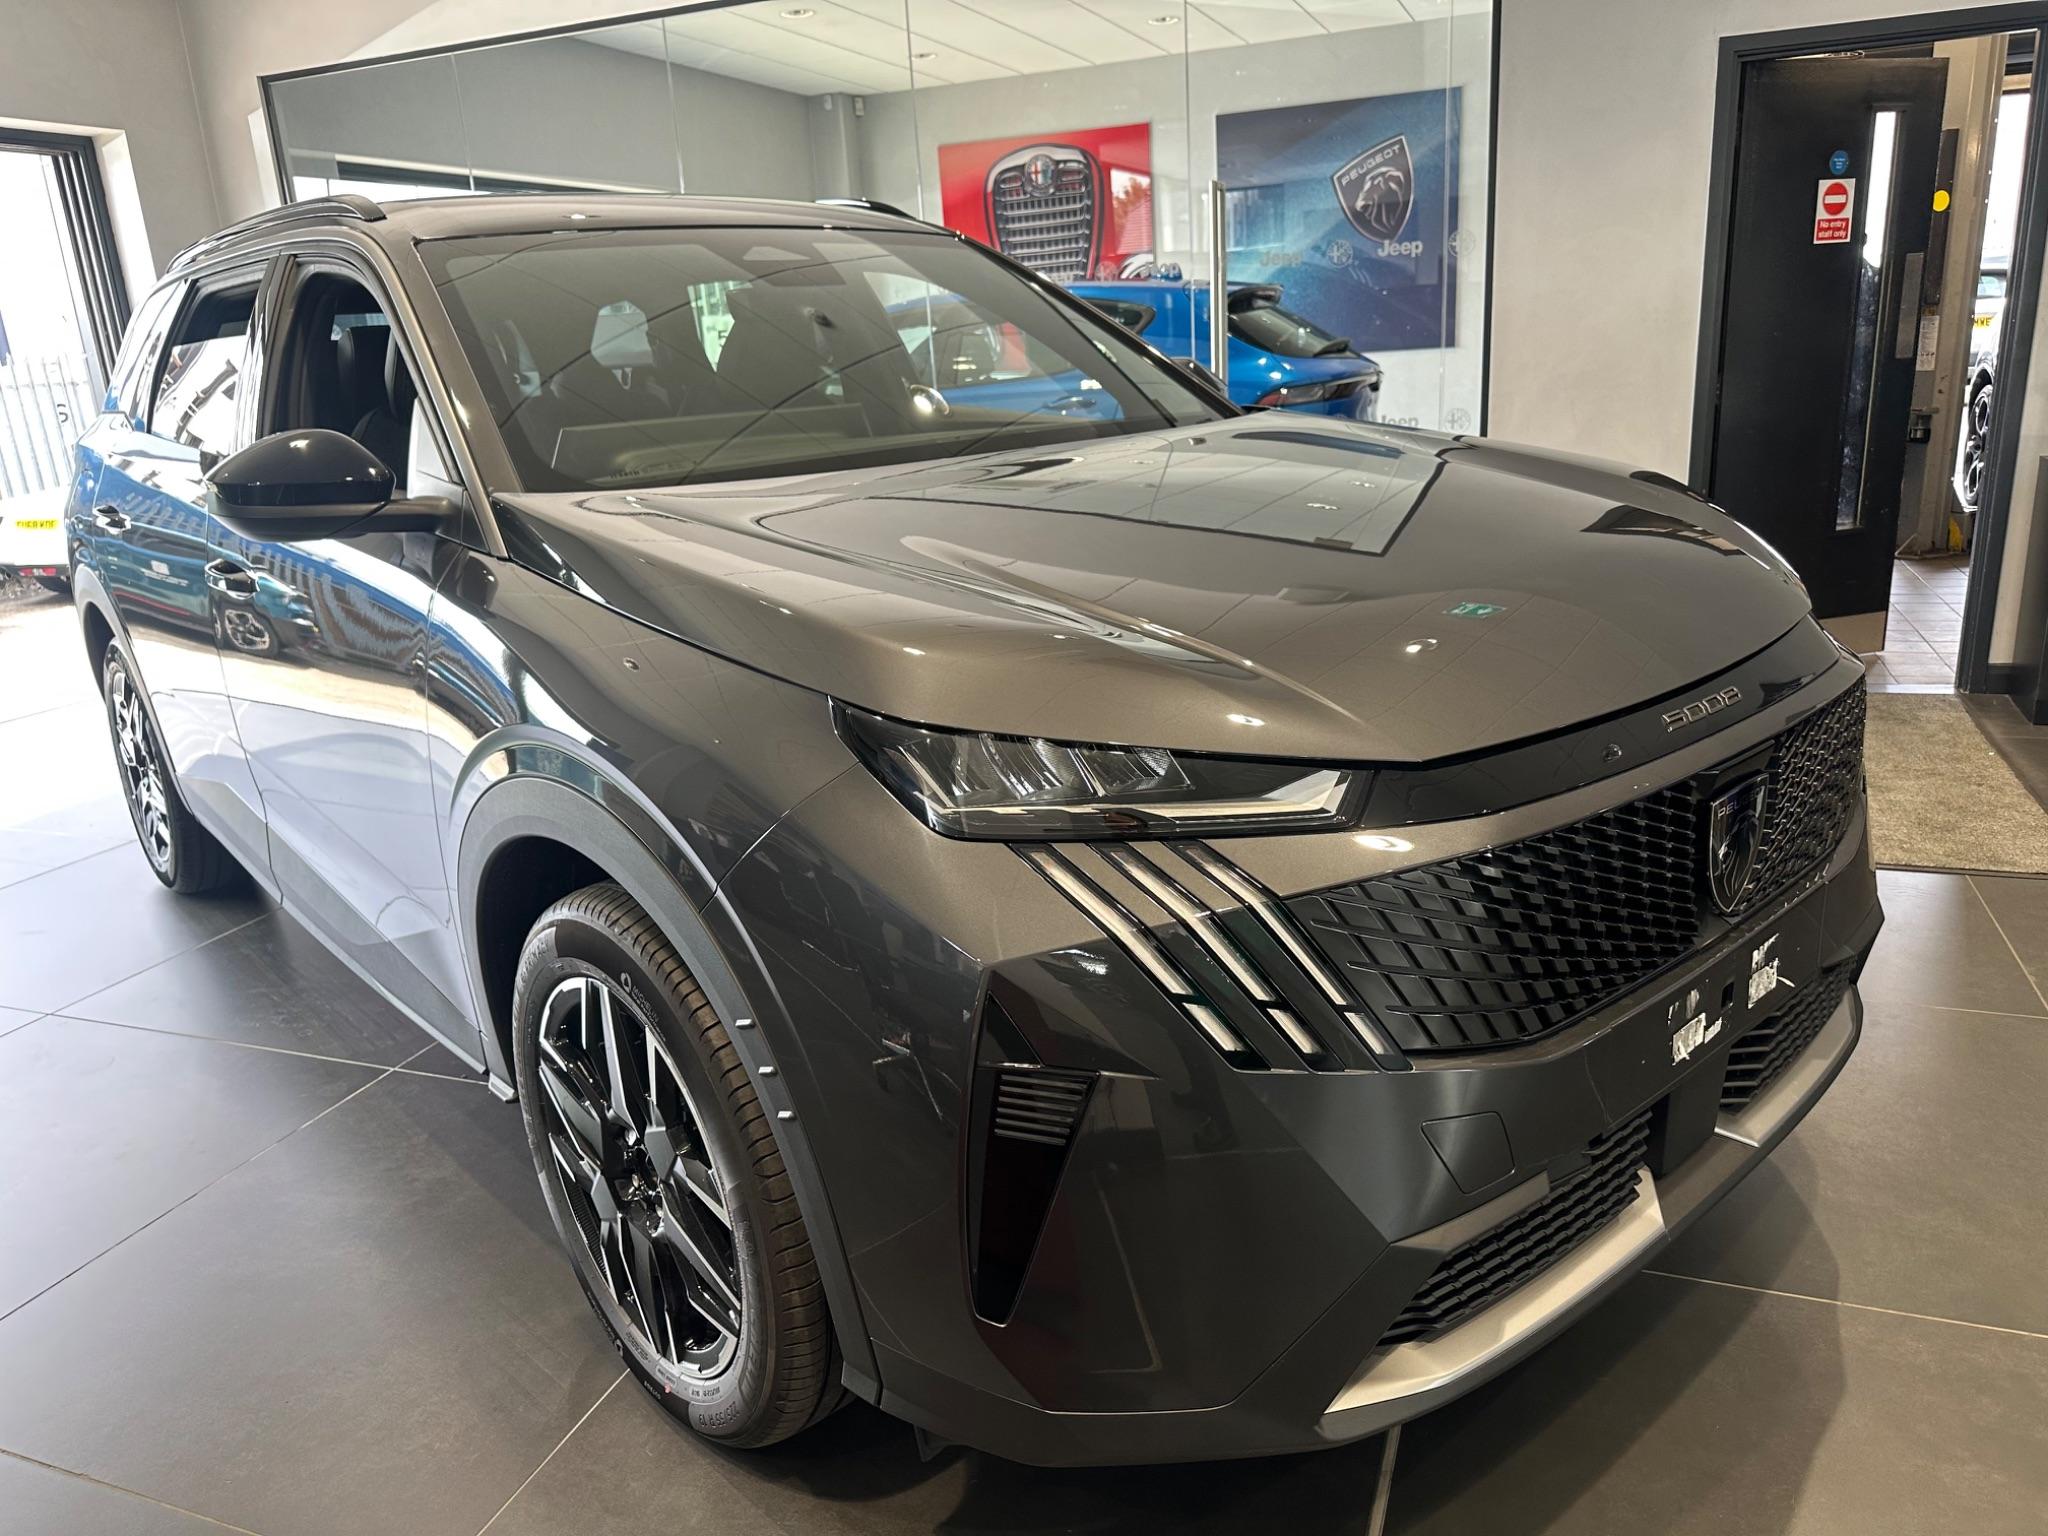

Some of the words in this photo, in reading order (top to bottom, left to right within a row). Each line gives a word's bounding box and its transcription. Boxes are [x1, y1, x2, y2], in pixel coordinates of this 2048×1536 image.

[1340, 143, 1401, 187] PEUGEOT
[1830, 221, 1846, 229] entry
[1833, 230, 1846, 239] only
[1377, 238, 1424, 257] Jeep
[1661, 686, 1743, 734] 5008
